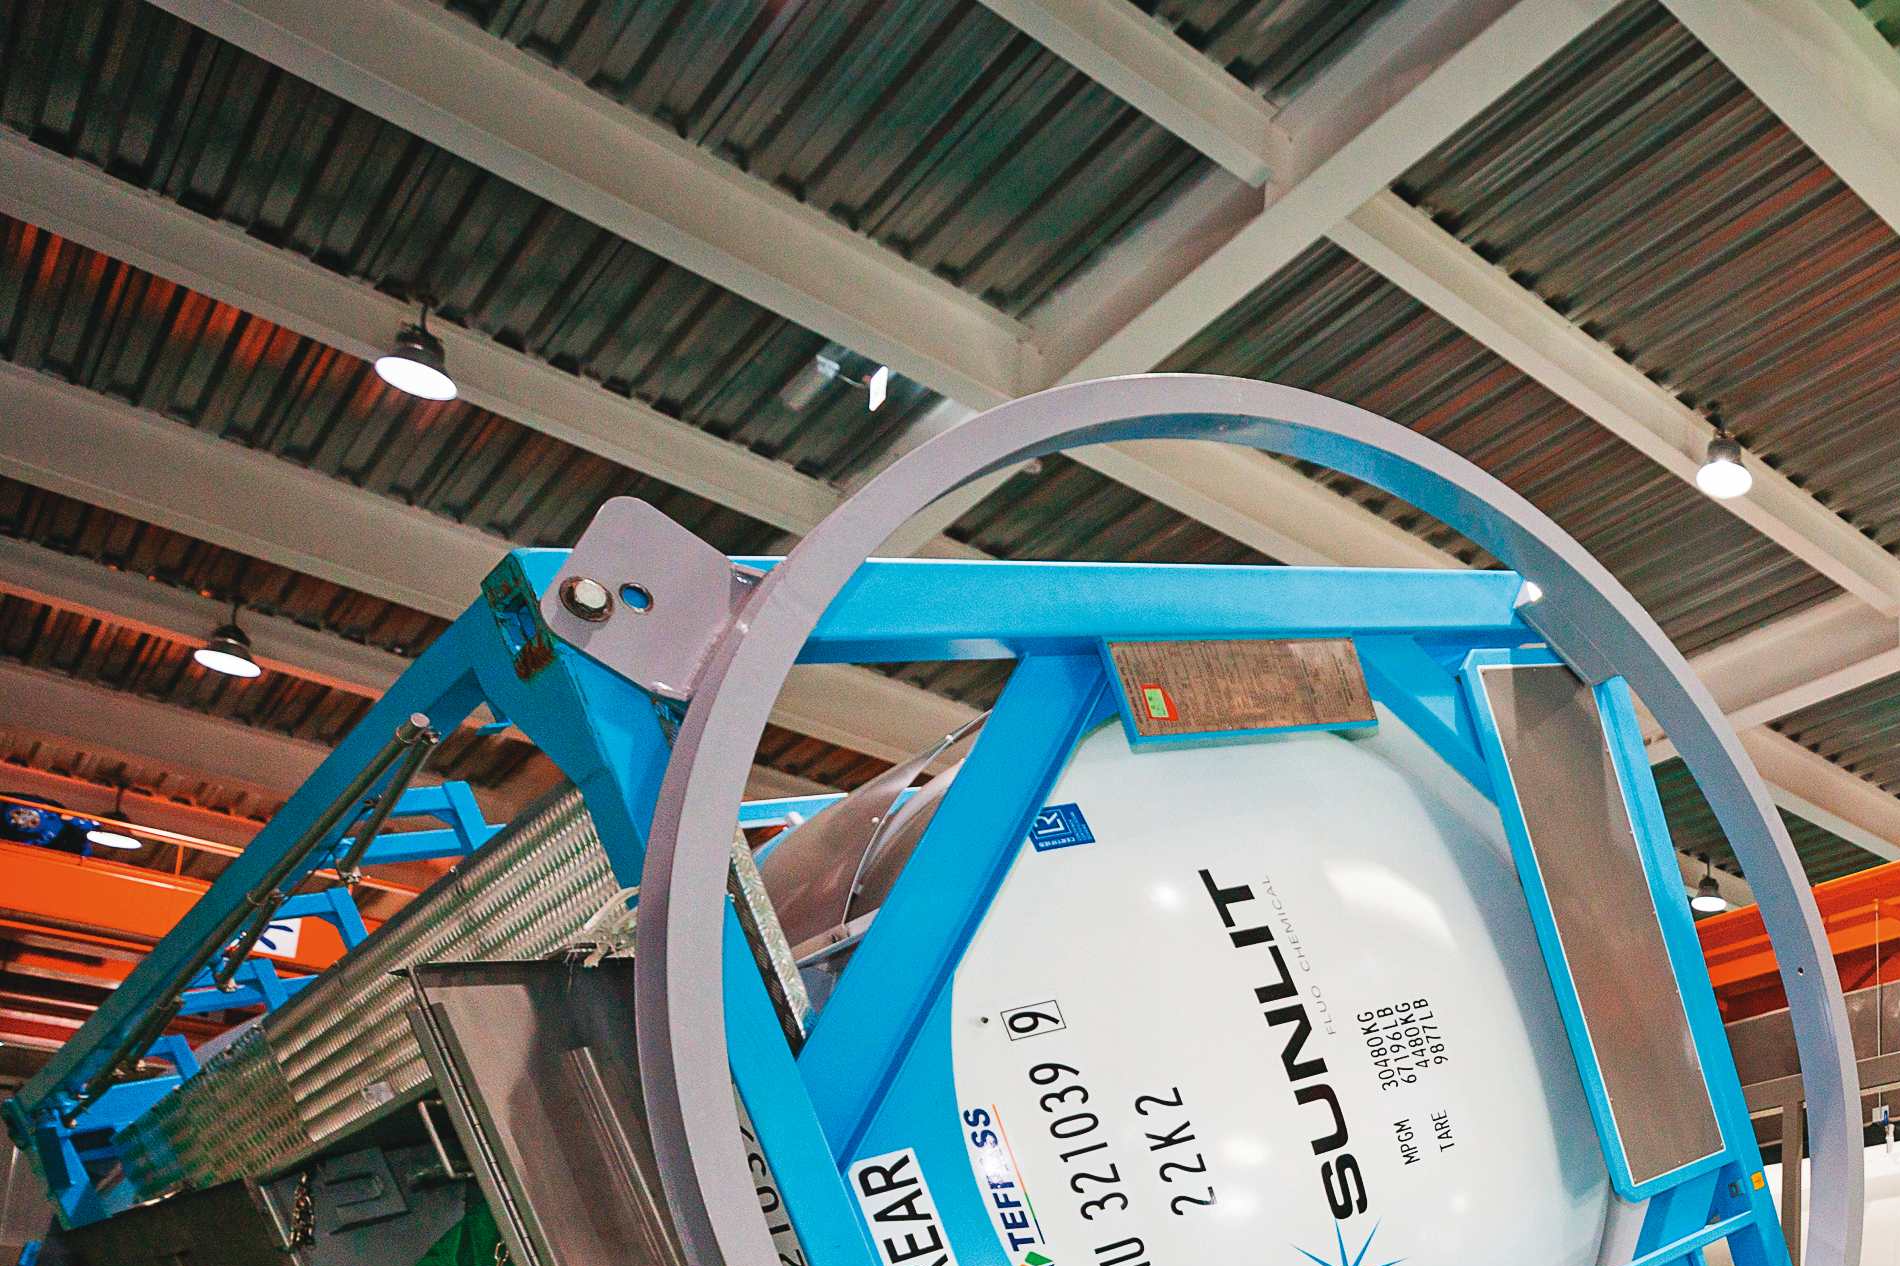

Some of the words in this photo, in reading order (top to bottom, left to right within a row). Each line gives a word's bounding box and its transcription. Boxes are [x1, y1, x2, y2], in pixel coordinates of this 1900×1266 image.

[1261, 875, 1311, 972] CHEMICAL
[1008, 1011, 1060, 1034] 9
[1198, 869, 1368, 1220] SUNLIT
[1311, 985, 1336, 1035] FLUO
[1376, 1007, 1417, 1084] 67196LB
[1395, 1002, 1430, 1068] 4480KG
[1412, 998, 1448, 1065] 9877LB
[1357, 1011, 1399, 1091] 30480KG
[1028, 1062, 1129, 1221] 321039
[1135, 1087, 1217, 1215] 22K2
[1393, 1119, 1420, 1165] MPGM
[1431, 1109, 1455, 1152] TARE
